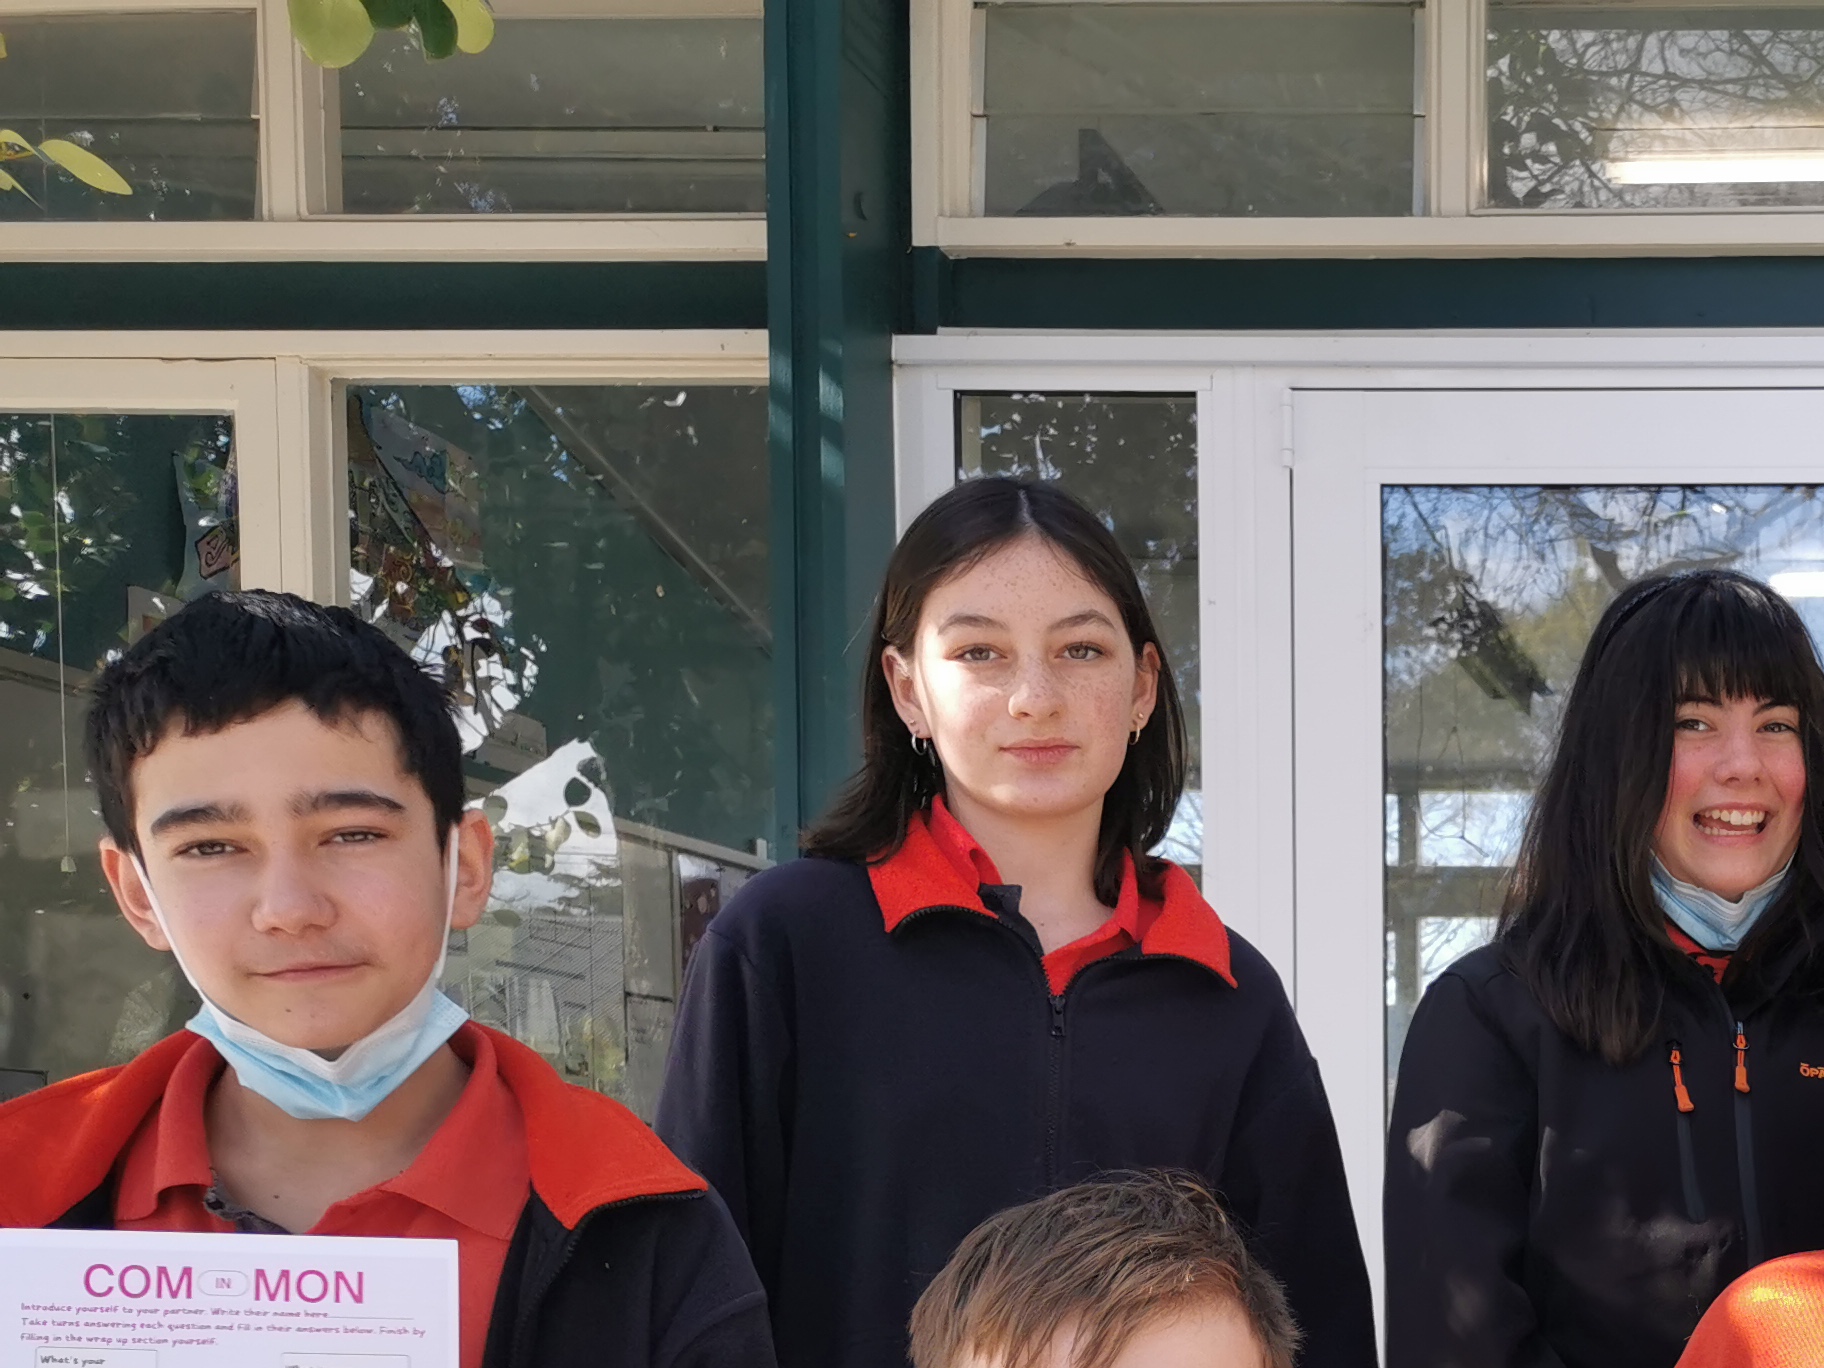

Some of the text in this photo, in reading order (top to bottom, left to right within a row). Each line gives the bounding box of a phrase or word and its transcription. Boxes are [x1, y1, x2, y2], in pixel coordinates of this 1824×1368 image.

[84, 1264, 364, 1304] COM IN MON
